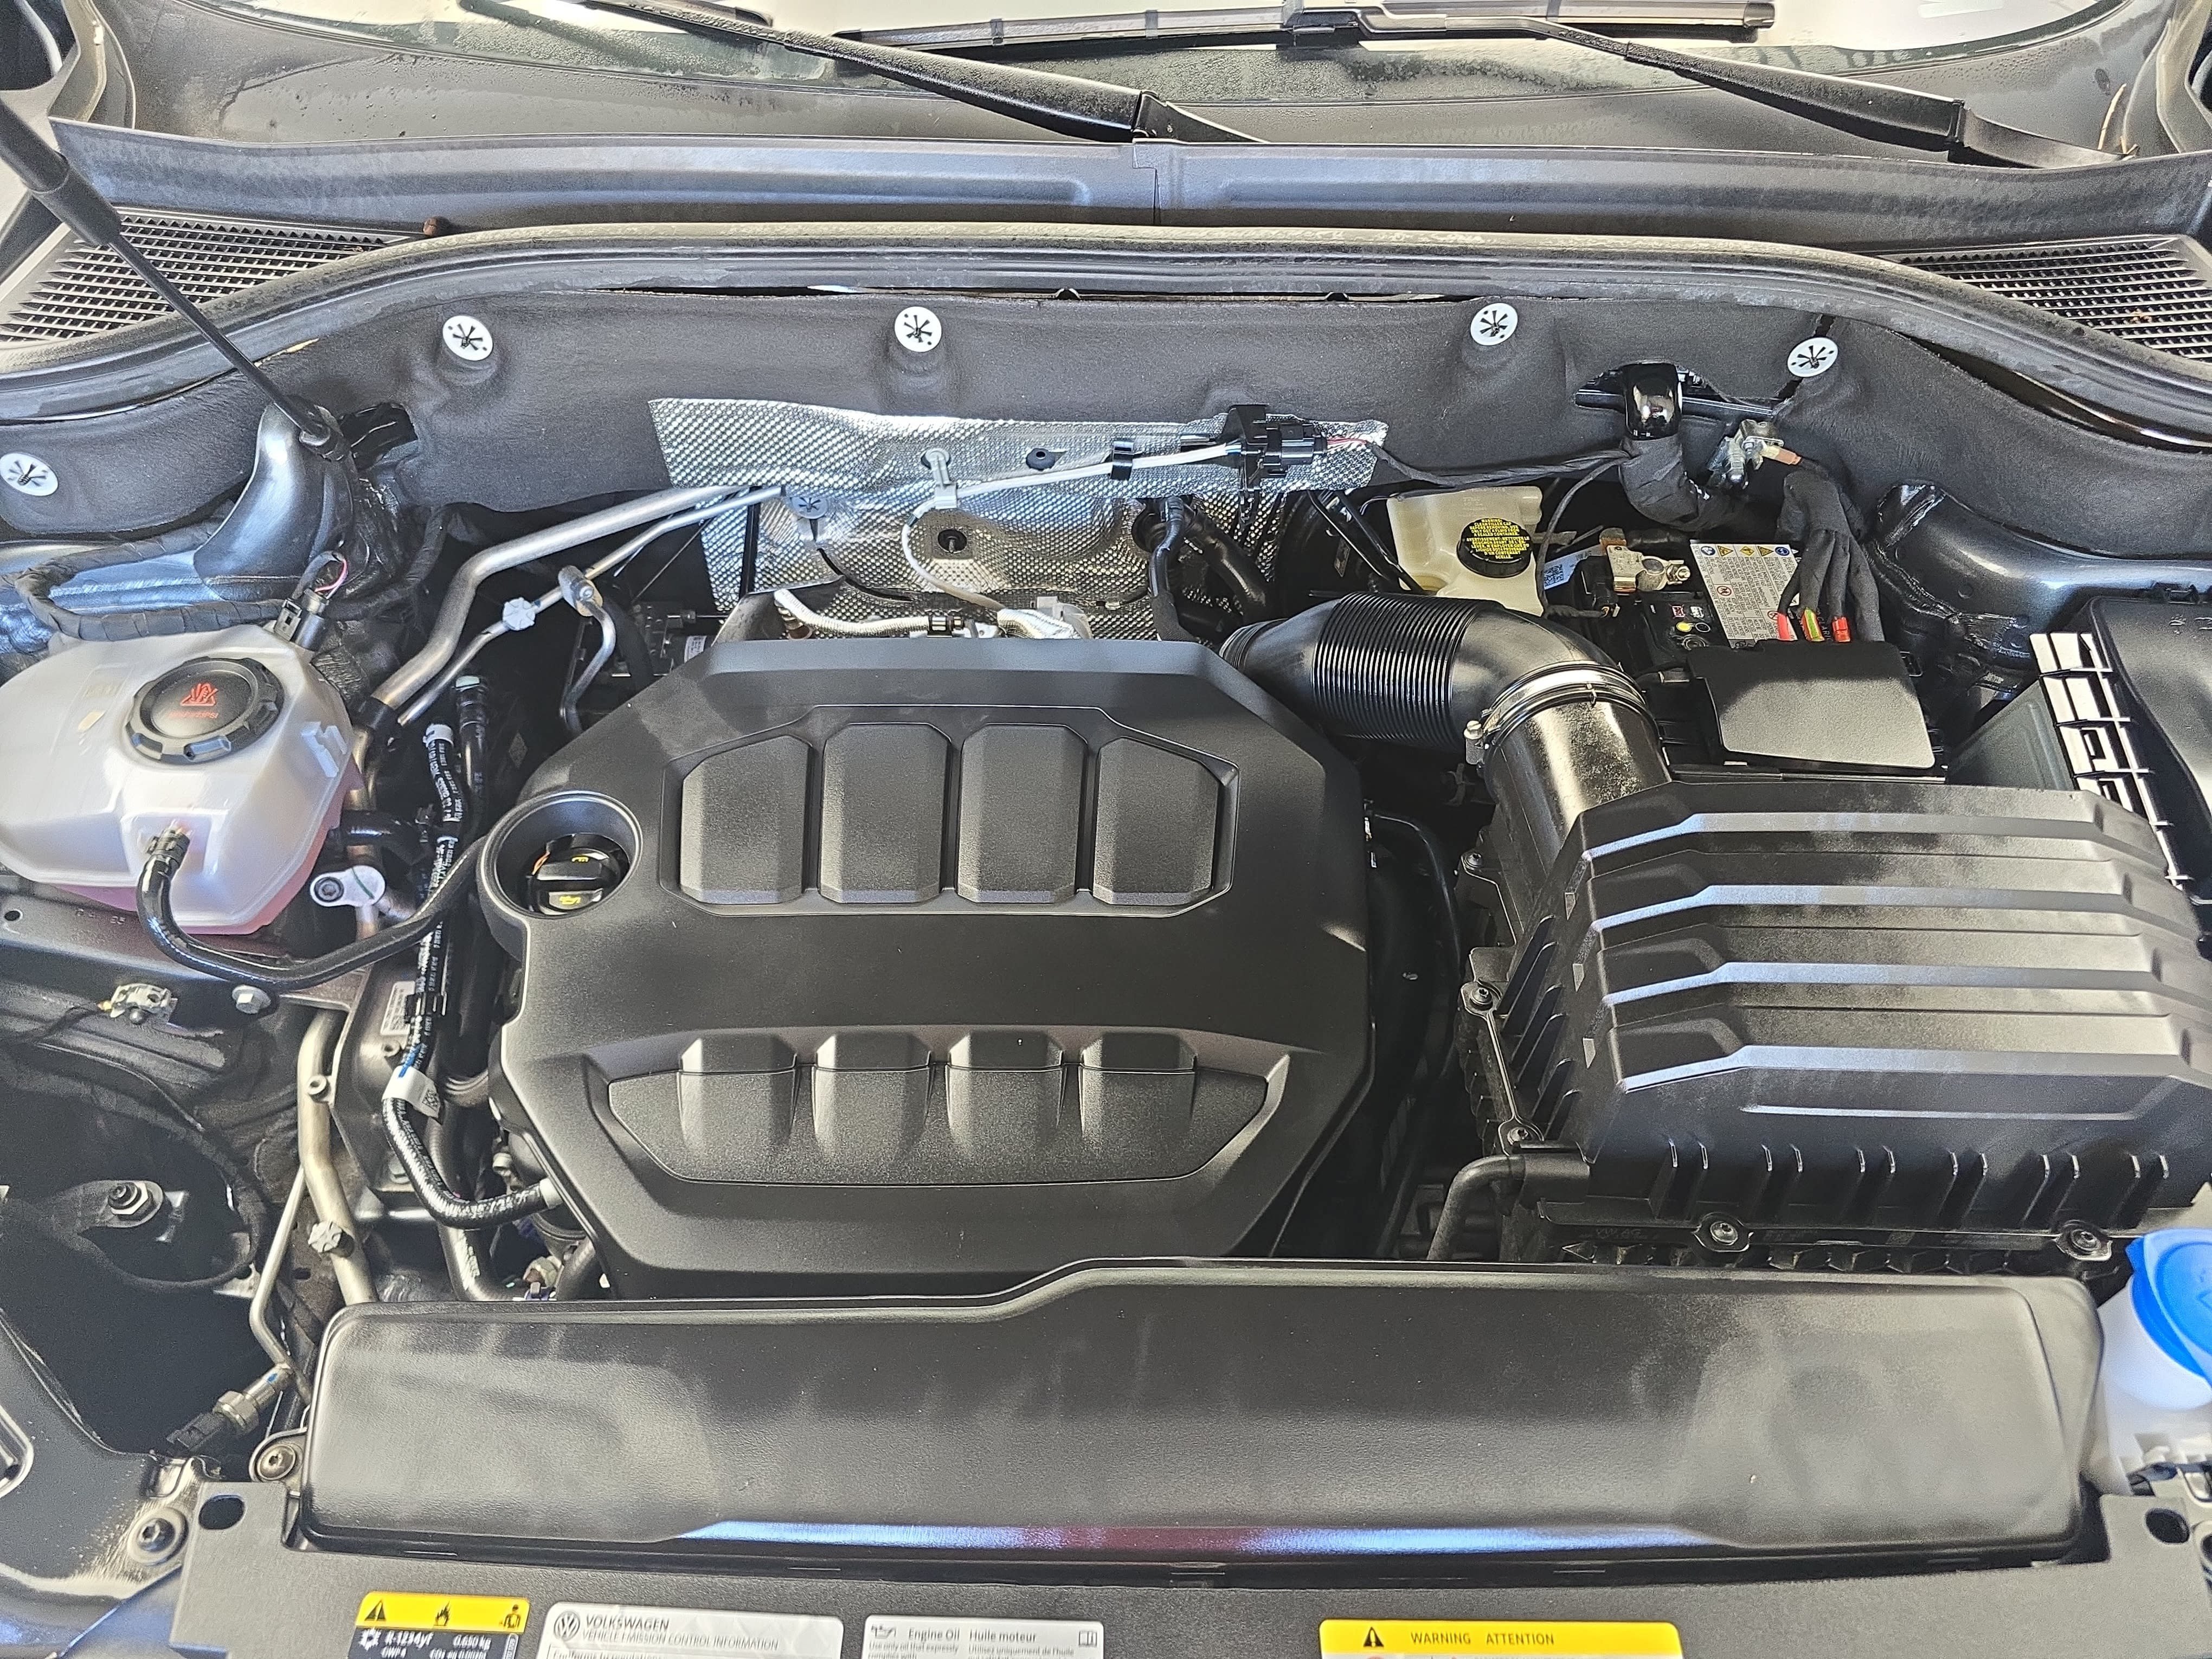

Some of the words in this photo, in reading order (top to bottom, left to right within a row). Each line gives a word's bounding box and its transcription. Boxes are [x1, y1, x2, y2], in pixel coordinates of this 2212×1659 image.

[586, 1613, 670, 1632] VOLKSWAGEN
[621, 1632, 666, 1644] EMISSION
[668, 1633, 710, 1647] CONTROL
[713, 1635, 779, 1651] INFORMATION
[908, 1627, 943, 1642] Engine
[946, 1628, 960, 1641] Oil
[969, 1629, 996, 1641] Huile
[999, 1631, 1036, 1643] moteur
[1411, 1631, 1471, 1644] WARNING
[1486, 1632, 1554, 1645] ATTENTION
